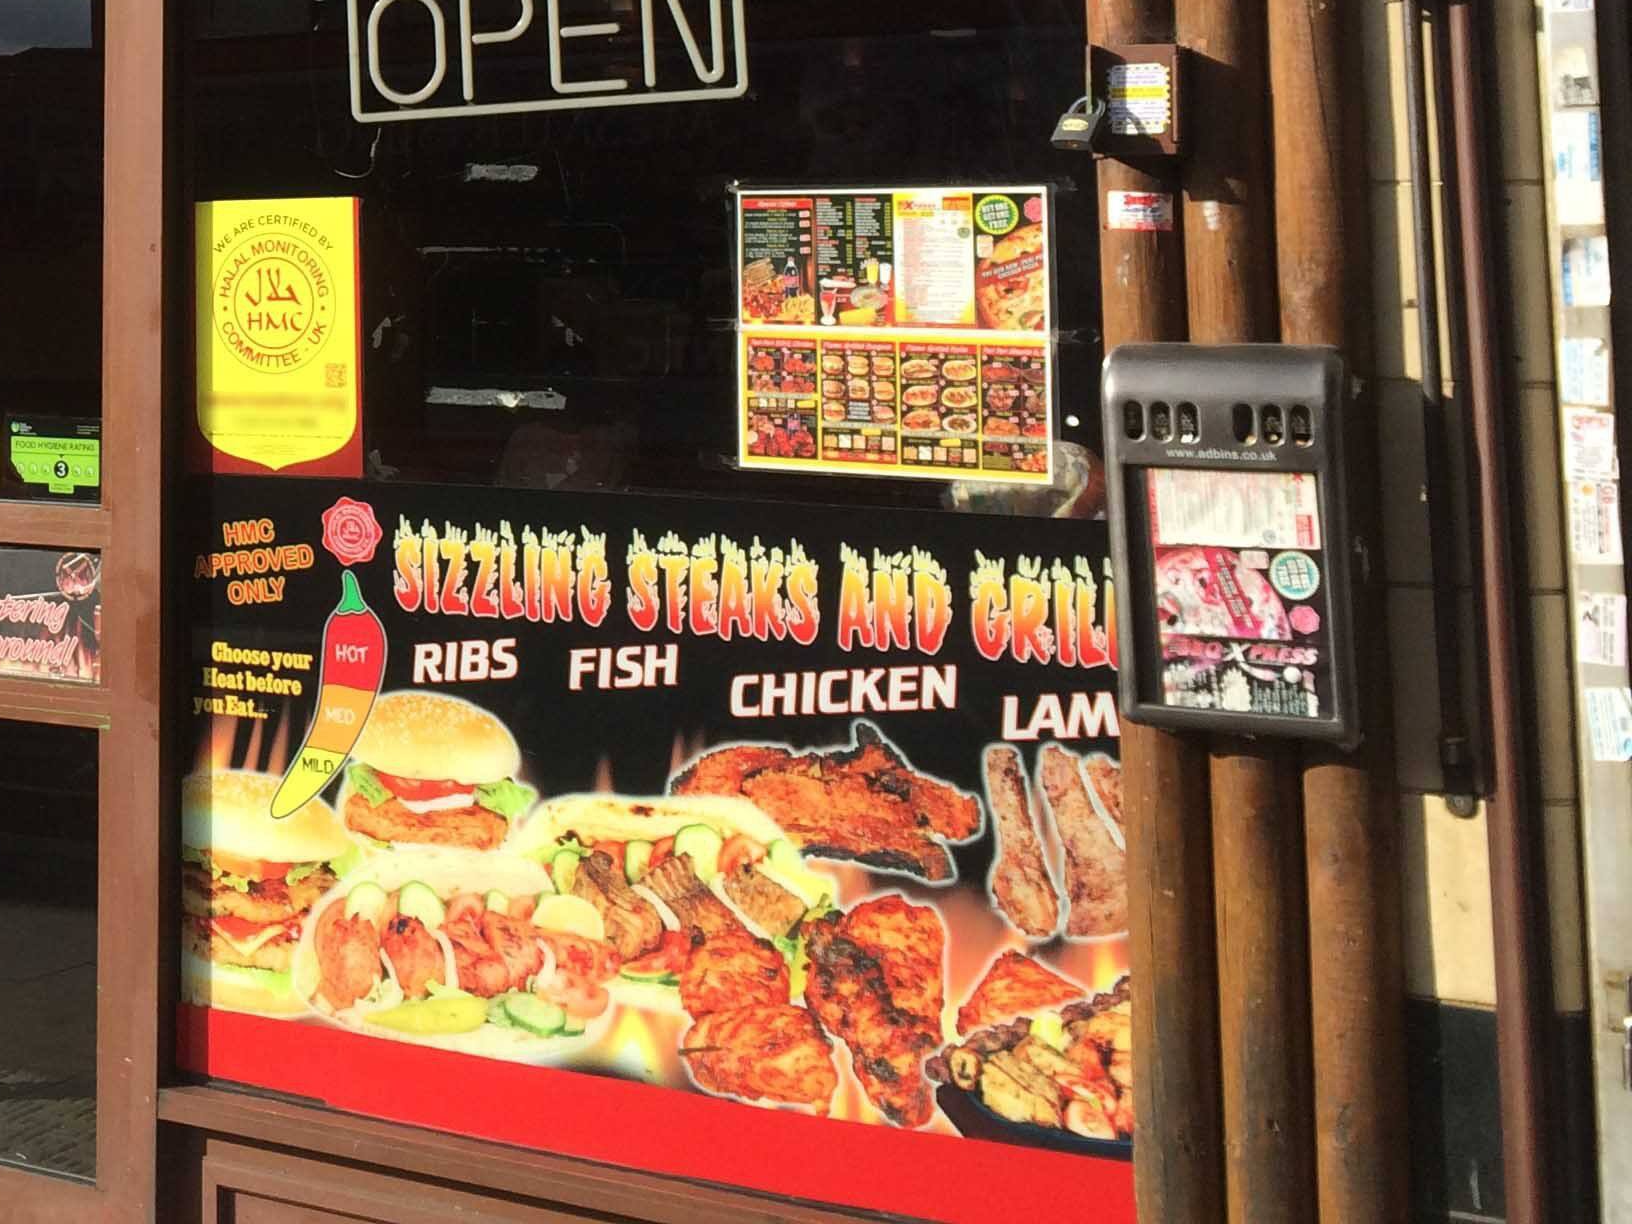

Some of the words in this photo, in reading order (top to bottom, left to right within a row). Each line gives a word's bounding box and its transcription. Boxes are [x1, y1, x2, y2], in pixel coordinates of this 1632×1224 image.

[213, 233, 233, 254] WE
[233, 218, 256, 239] ARE
[257, 214, 319, 239] CERTIFIED
[318, 232, 334, 252] BY
[218, 252, 249, 299] HALAL
[251, 239, 330, 299] MONITORING
[247, 312, 304, 332] HMC
[221, 321, 303, 369] COMMITTEE
[307, 321, 329, 347] UK
[15, 440, 37, 449] FOOD
[56, 462, 66, 477] 3
[222, 517, 276, 548] HMC
[194, 543, 315, 579] APPROVED
[227, 576, 286, 606] ONLY
[393, 514, 613, 628] SIZZLING
[625, 527, 821, 646] STEAKS
[837, 541, 954, 656] AND
[211, 640, 270, 667] Choose
[270, 650, 313, 674] your
[335, 643, 369, 665] HOT
[202, 665, 243, 693] Heat
[243, 670, 303, 696] before
[413, 638, 518, 684] RIBS
[569, 644, 678, 691] FISH
[730, 664, 957, 718] CHICKEN
[193, 697, 225, 718] you
[324, 706, 356, 726] MED
[302, 755, 335, 776] MILD
